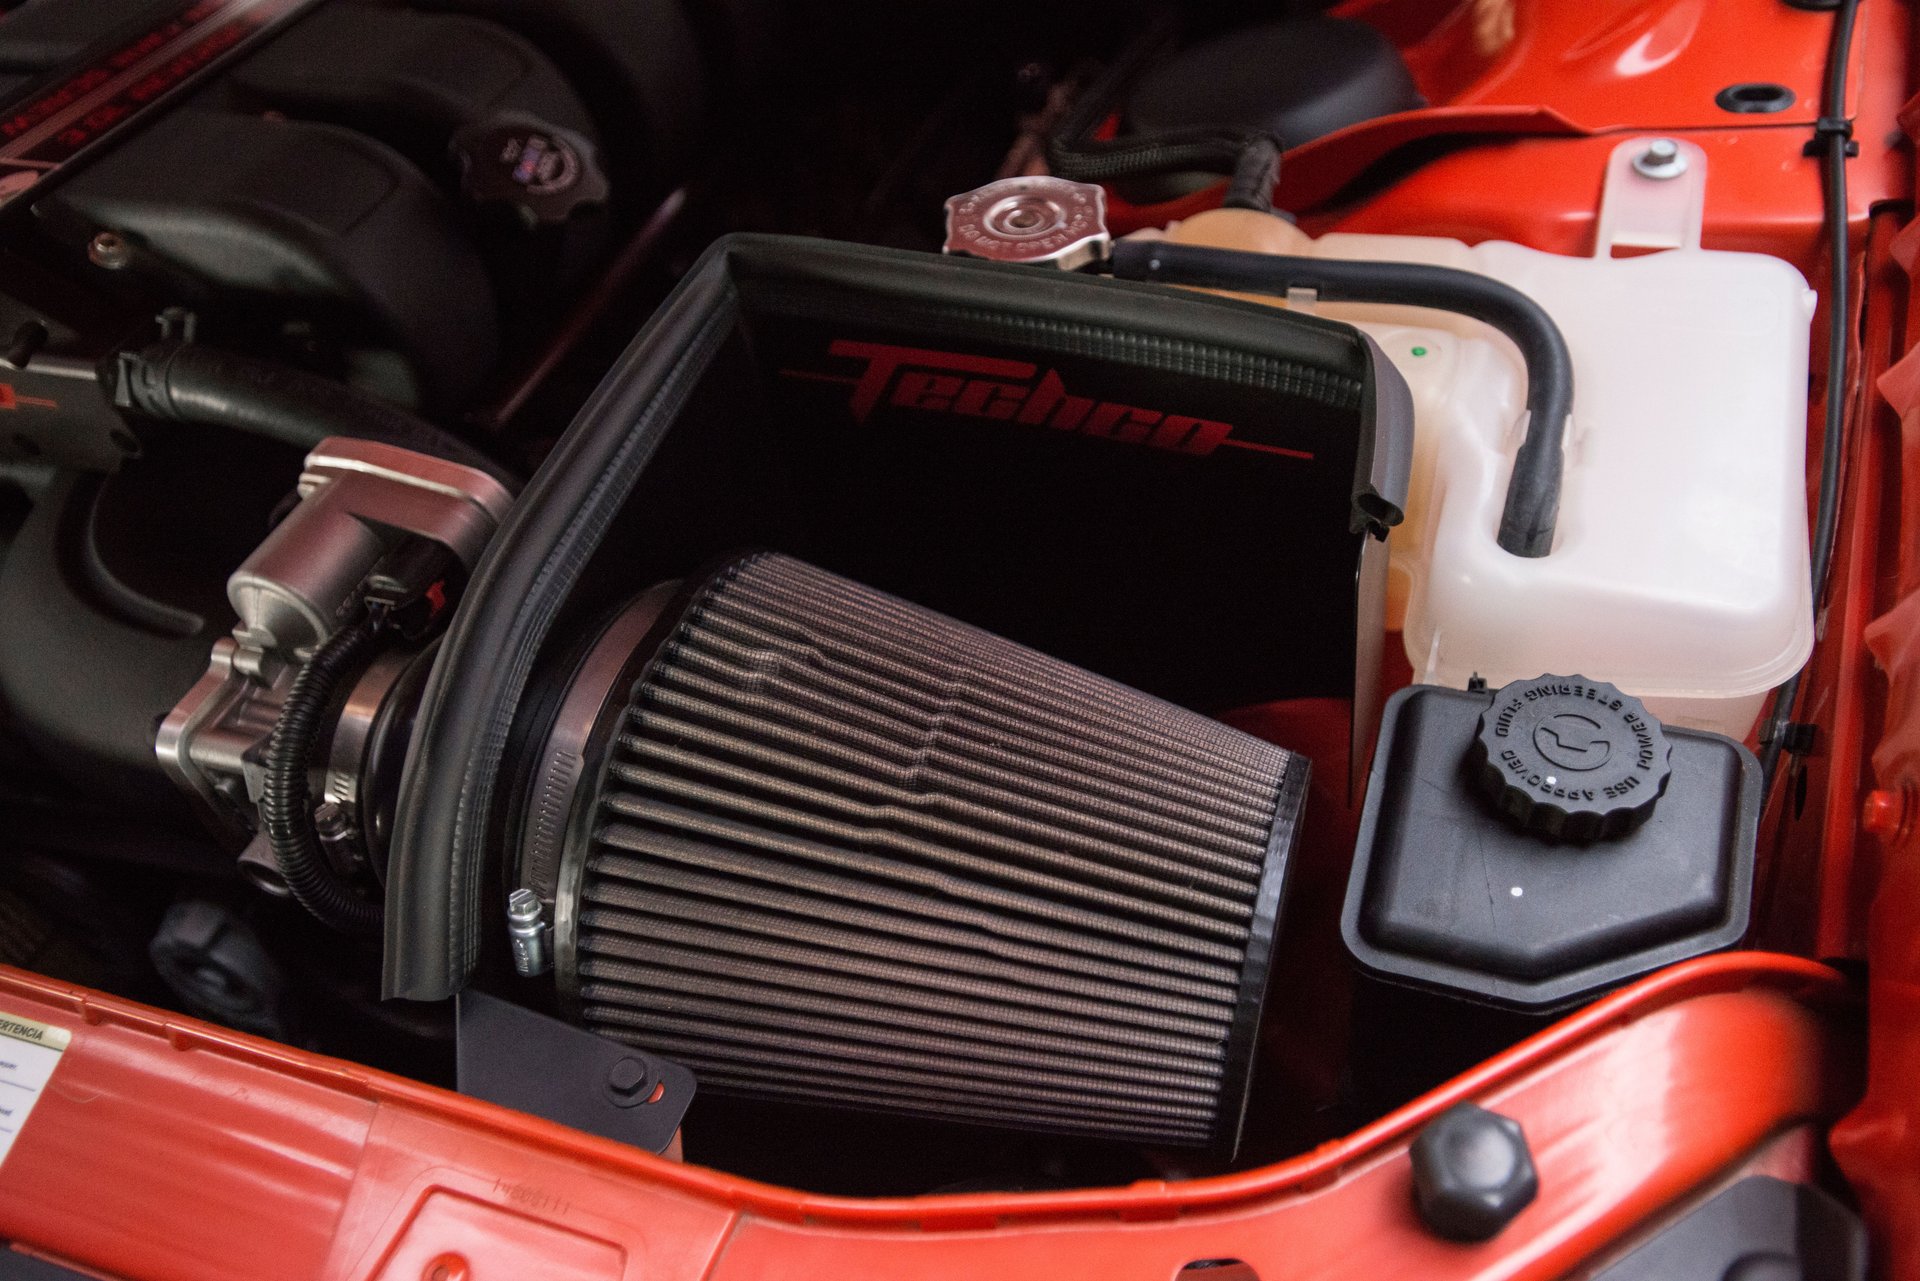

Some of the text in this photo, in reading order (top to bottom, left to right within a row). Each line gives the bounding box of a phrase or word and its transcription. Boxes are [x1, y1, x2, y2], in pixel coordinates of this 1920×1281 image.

[829, 339, 1234, 455] Techco
[1495, 683, 1654, 770] POWER STEERING FLUID
[1501, 749, 1640, 801] USE APPROVED
